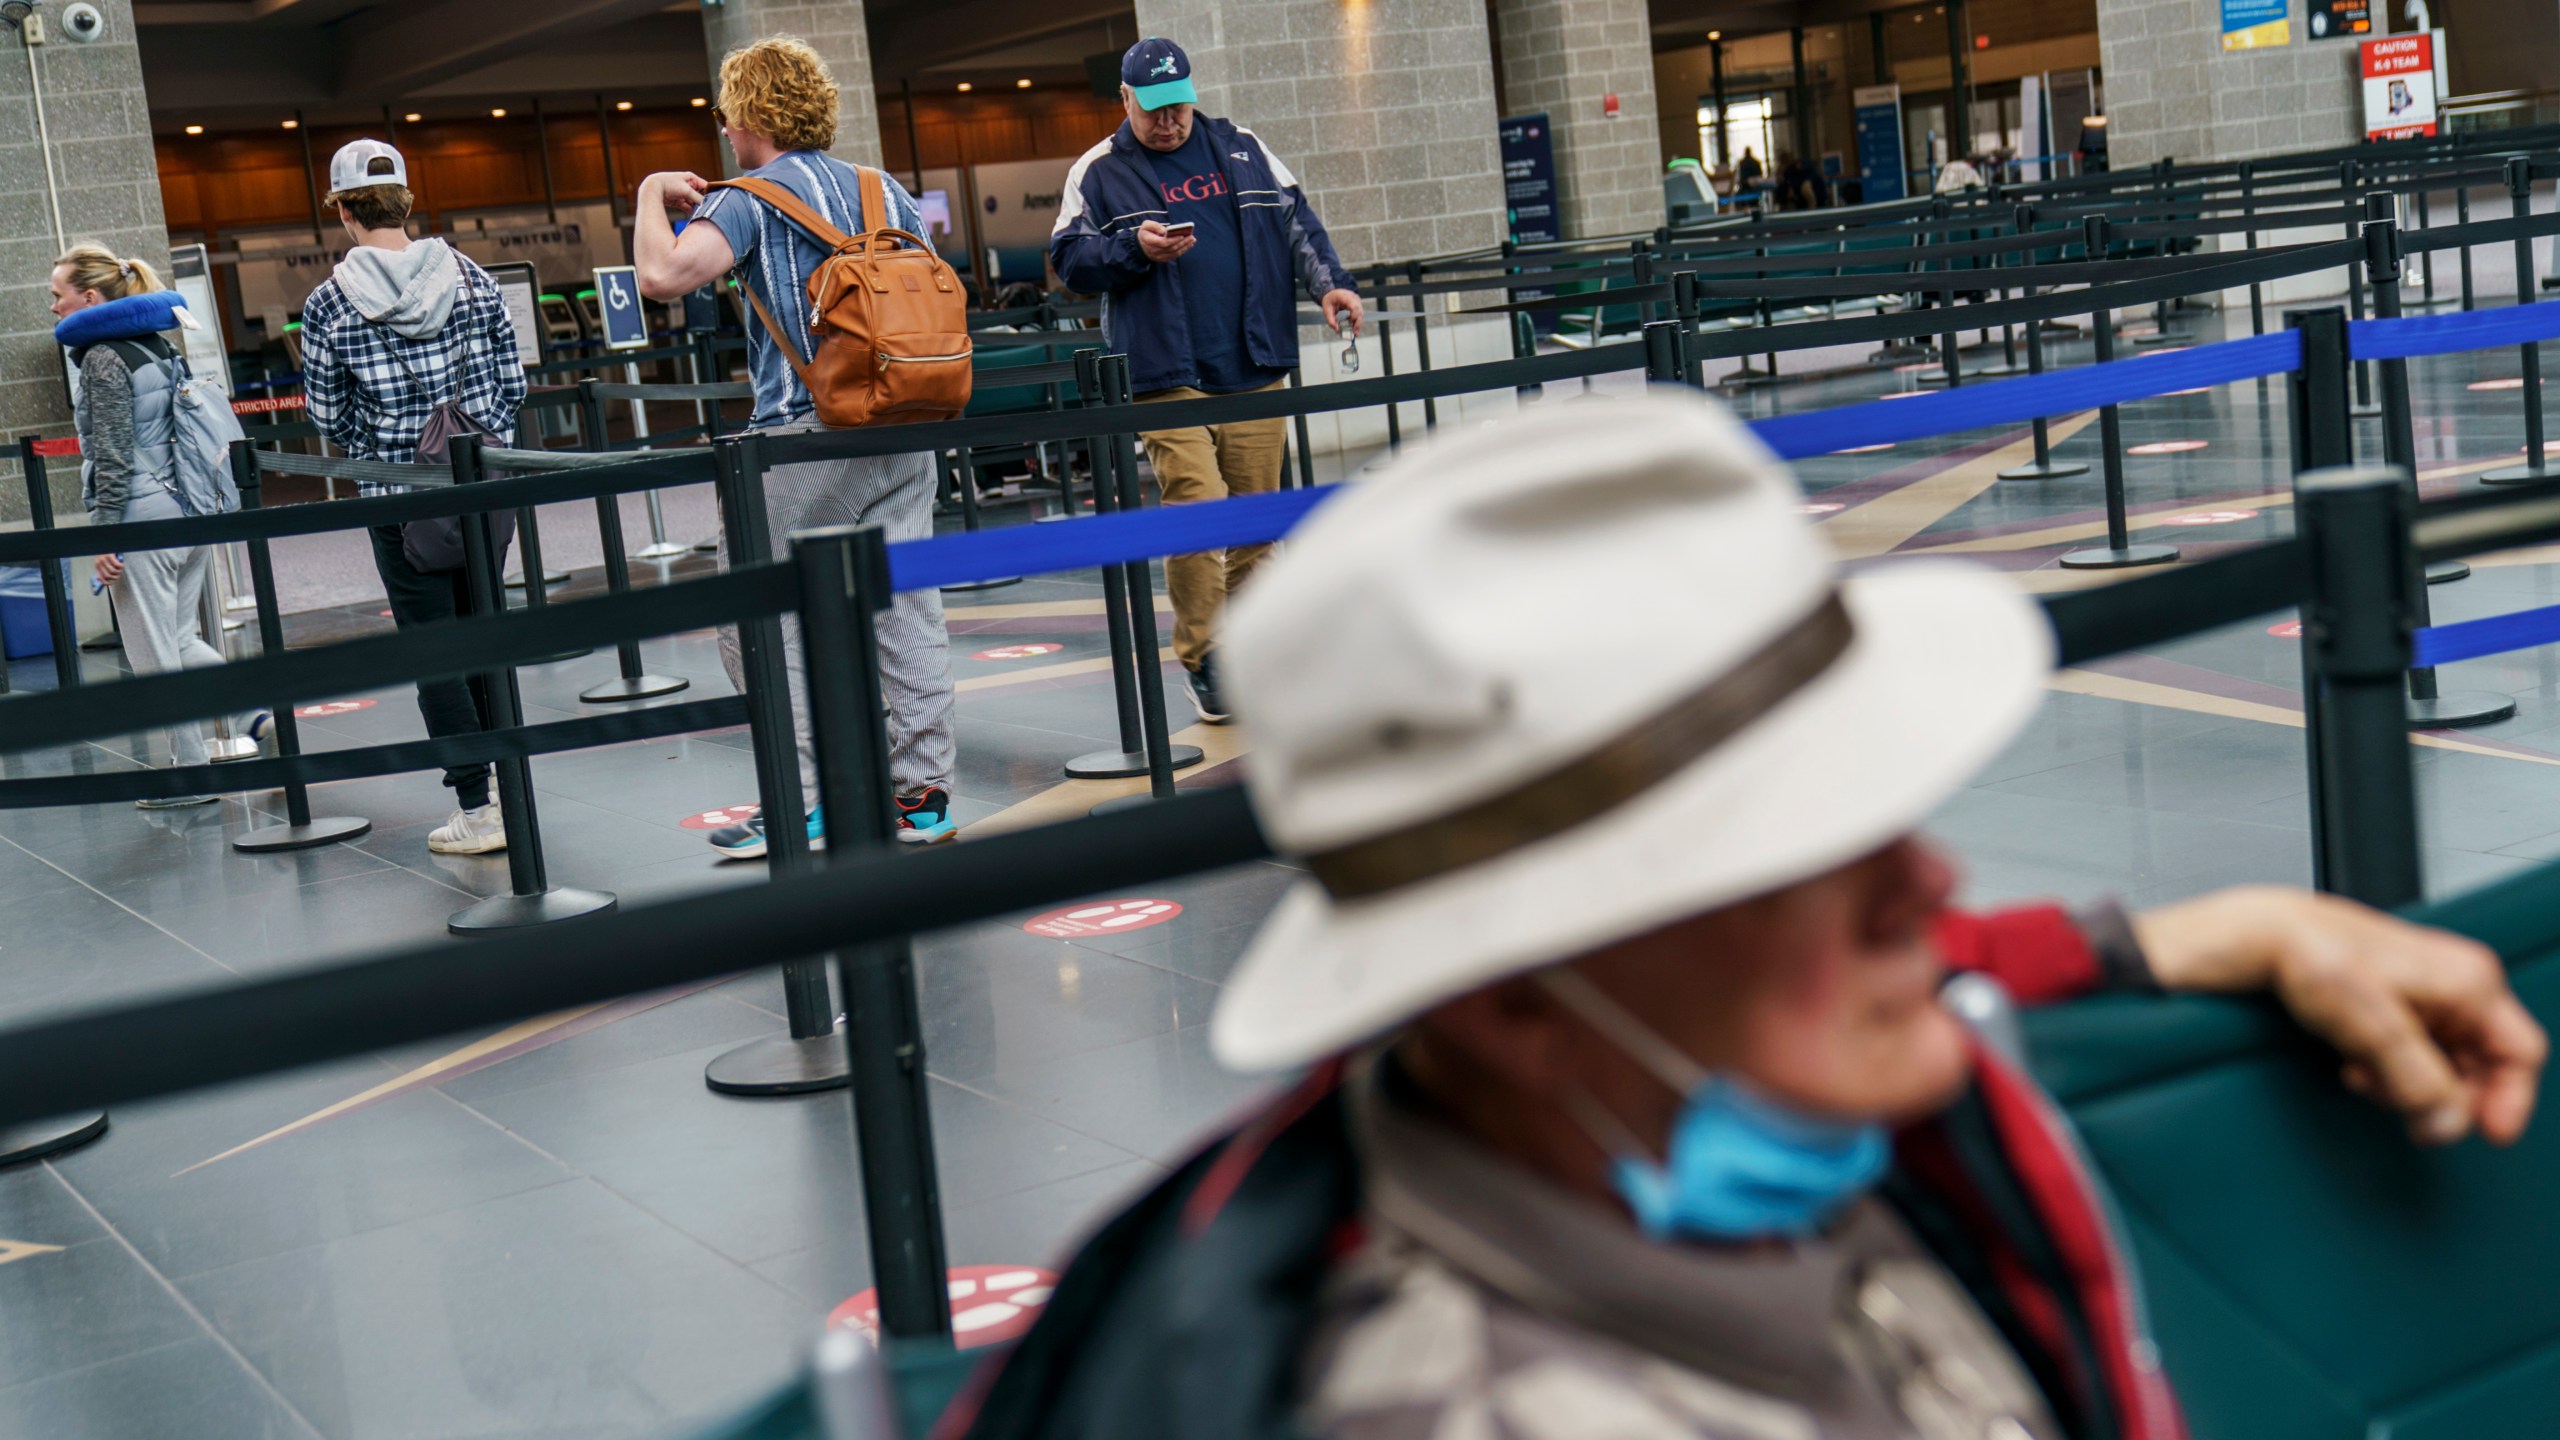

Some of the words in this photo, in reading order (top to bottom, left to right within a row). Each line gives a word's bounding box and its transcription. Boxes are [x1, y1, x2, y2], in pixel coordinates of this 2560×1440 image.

[2373, 40, 2418, 56] CAUTION
[2373, 58, 2391, 72] K-9
[2393, 55, 2419, 70] TEAM
[1160, 170, 1228, 203] cGil
[1023, 188, 1063, 210] Ameri
[286, 250, 343, 267] UNITE
[232, 400, 277, 414] STRICTED
[280, 396, 304, 409] AREA
